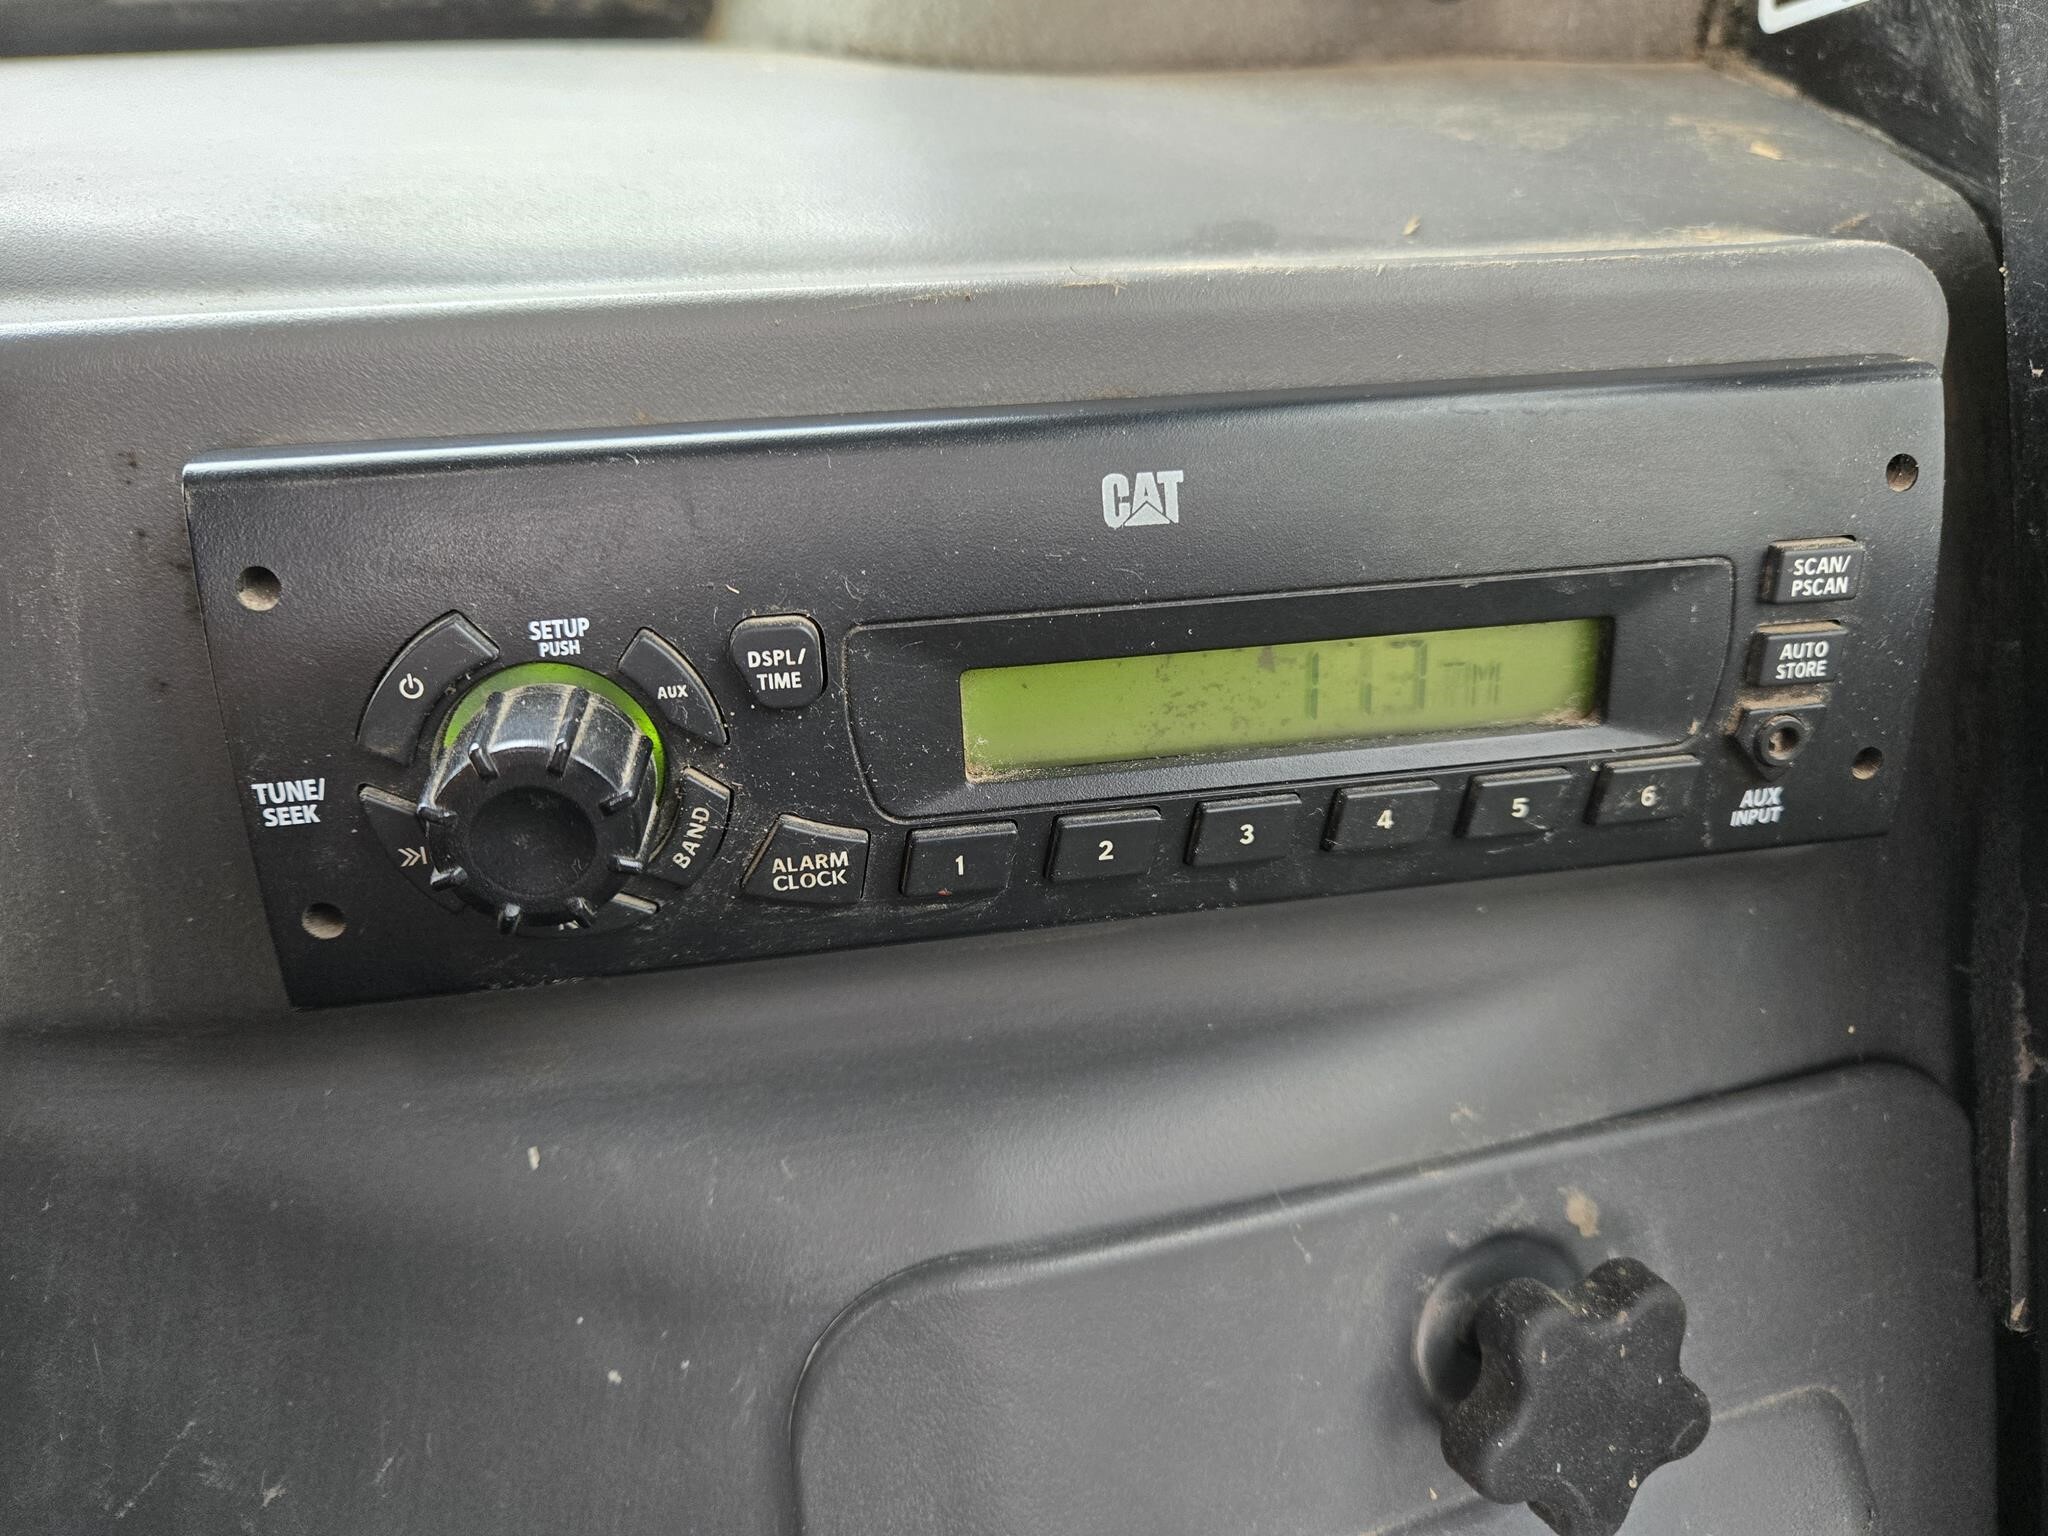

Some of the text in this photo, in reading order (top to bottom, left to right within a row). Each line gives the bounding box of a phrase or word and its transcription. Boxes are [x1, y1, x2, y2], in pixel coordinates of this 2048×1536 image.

[1101, 470, 1184, 529] CAT
[1793, 556, 1851, 577] SCAN/
[1791, 577, 1849, 597] PSCAN
[528, 618, 590, 640] SETUP
[539, 641, 581, 657] PUSH
[747, 647, 806, 668] DSPL/
[1779, 641, 1829, 660] AUTO
[1775, 661, 1827, 680] STORE
[757, 672, 802, 691] TIME
[657, 685, 688, 700] AUX
[251, 778, 326, 805] TUNE/
[1640, 785, 1657, 807] 6
[1739, 787, 1783, 808] AUX
[262, 804, 320, 828] SEEK
[1511, 797, 1530, 818] 5
[1730, 806, 1784, 827] INPUT
[1376, 809, 1394, 829] 4
[672, 806, 710, 869] BAND
[1239, 823, 1255, 845] 3
[1098, 840, 1114, 861] 2
[771, 851, 849, 874] ALARM
[955, 856, 964, 876] 1
[772, 870, 848, 893] CLOCK
